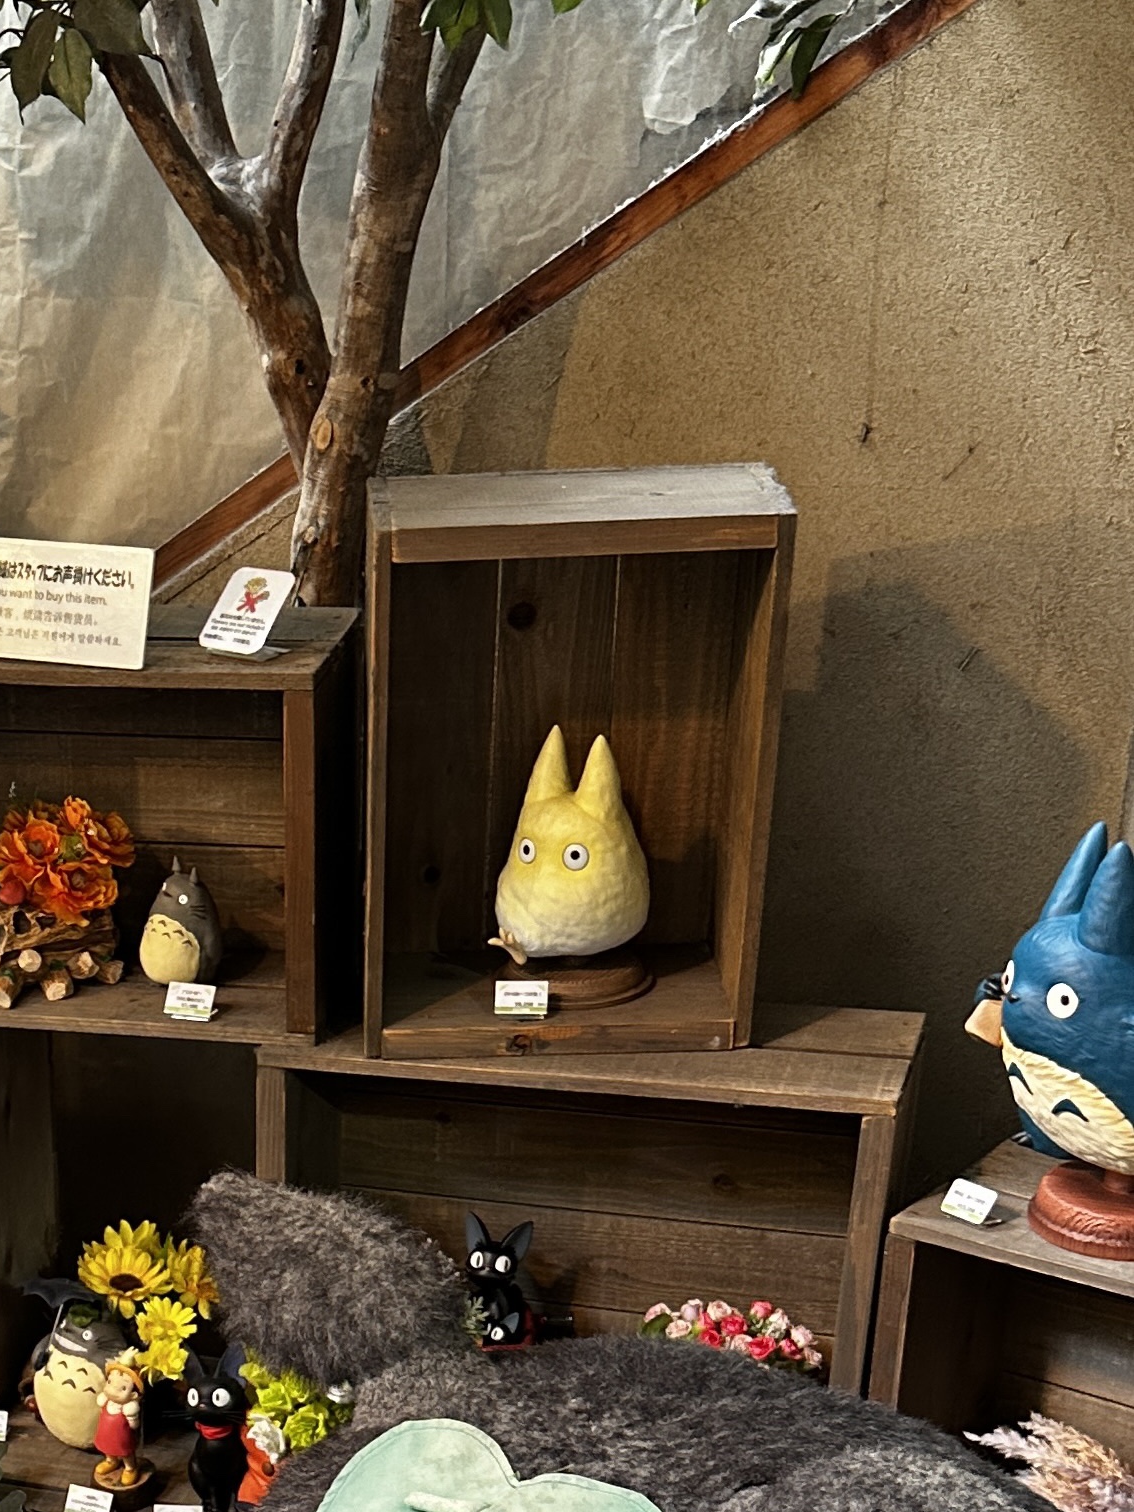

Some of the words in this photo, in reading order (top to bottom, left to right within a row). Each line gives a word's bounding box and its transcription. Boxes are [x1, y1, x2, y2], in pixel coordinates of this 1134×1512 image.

[9, 589, 32, 600] want
[34, 590, 45, 600] to
[46, 590, 64, 604] buy
[65, 592, 83, 604] this
[84, 593, 108, 606] item.
